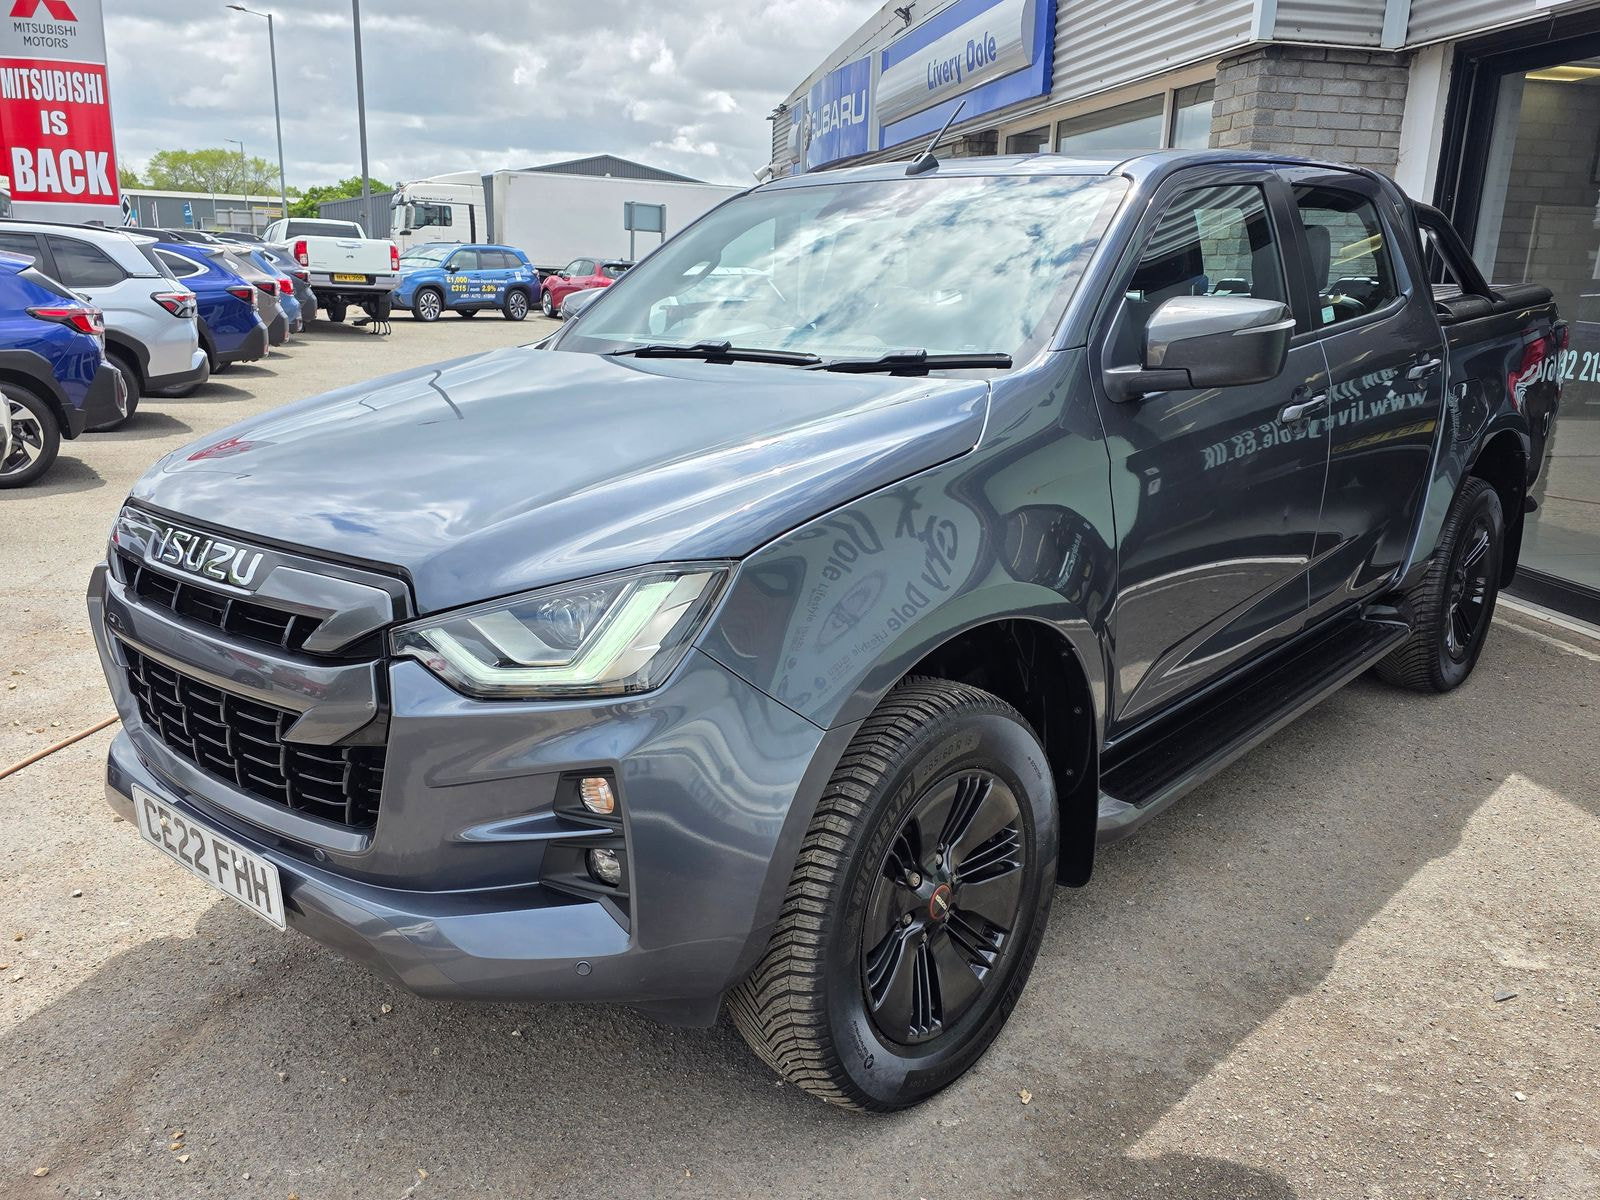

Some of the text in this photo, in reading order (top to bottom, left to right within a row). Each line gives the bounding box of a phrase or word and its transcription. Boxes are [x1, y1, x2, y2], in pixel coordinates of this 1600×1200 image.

[13, 22, 77, 37] MITSUBISHI
[23, 36, 69, 49] MOTORS
[928, 31, 998, 90] Livery Dole
[0, 67, 104, 105] MITSUBISHI
[41, 109, 68, 136] IS
[11, 147, 113, 196] BACK
[451, 284, 467, 292] £315
[481, 284, 497, 292] 2.9%
[154, 526, 263, 587] ISUZU
[142, 797, 274, 916] CE22 FHH
